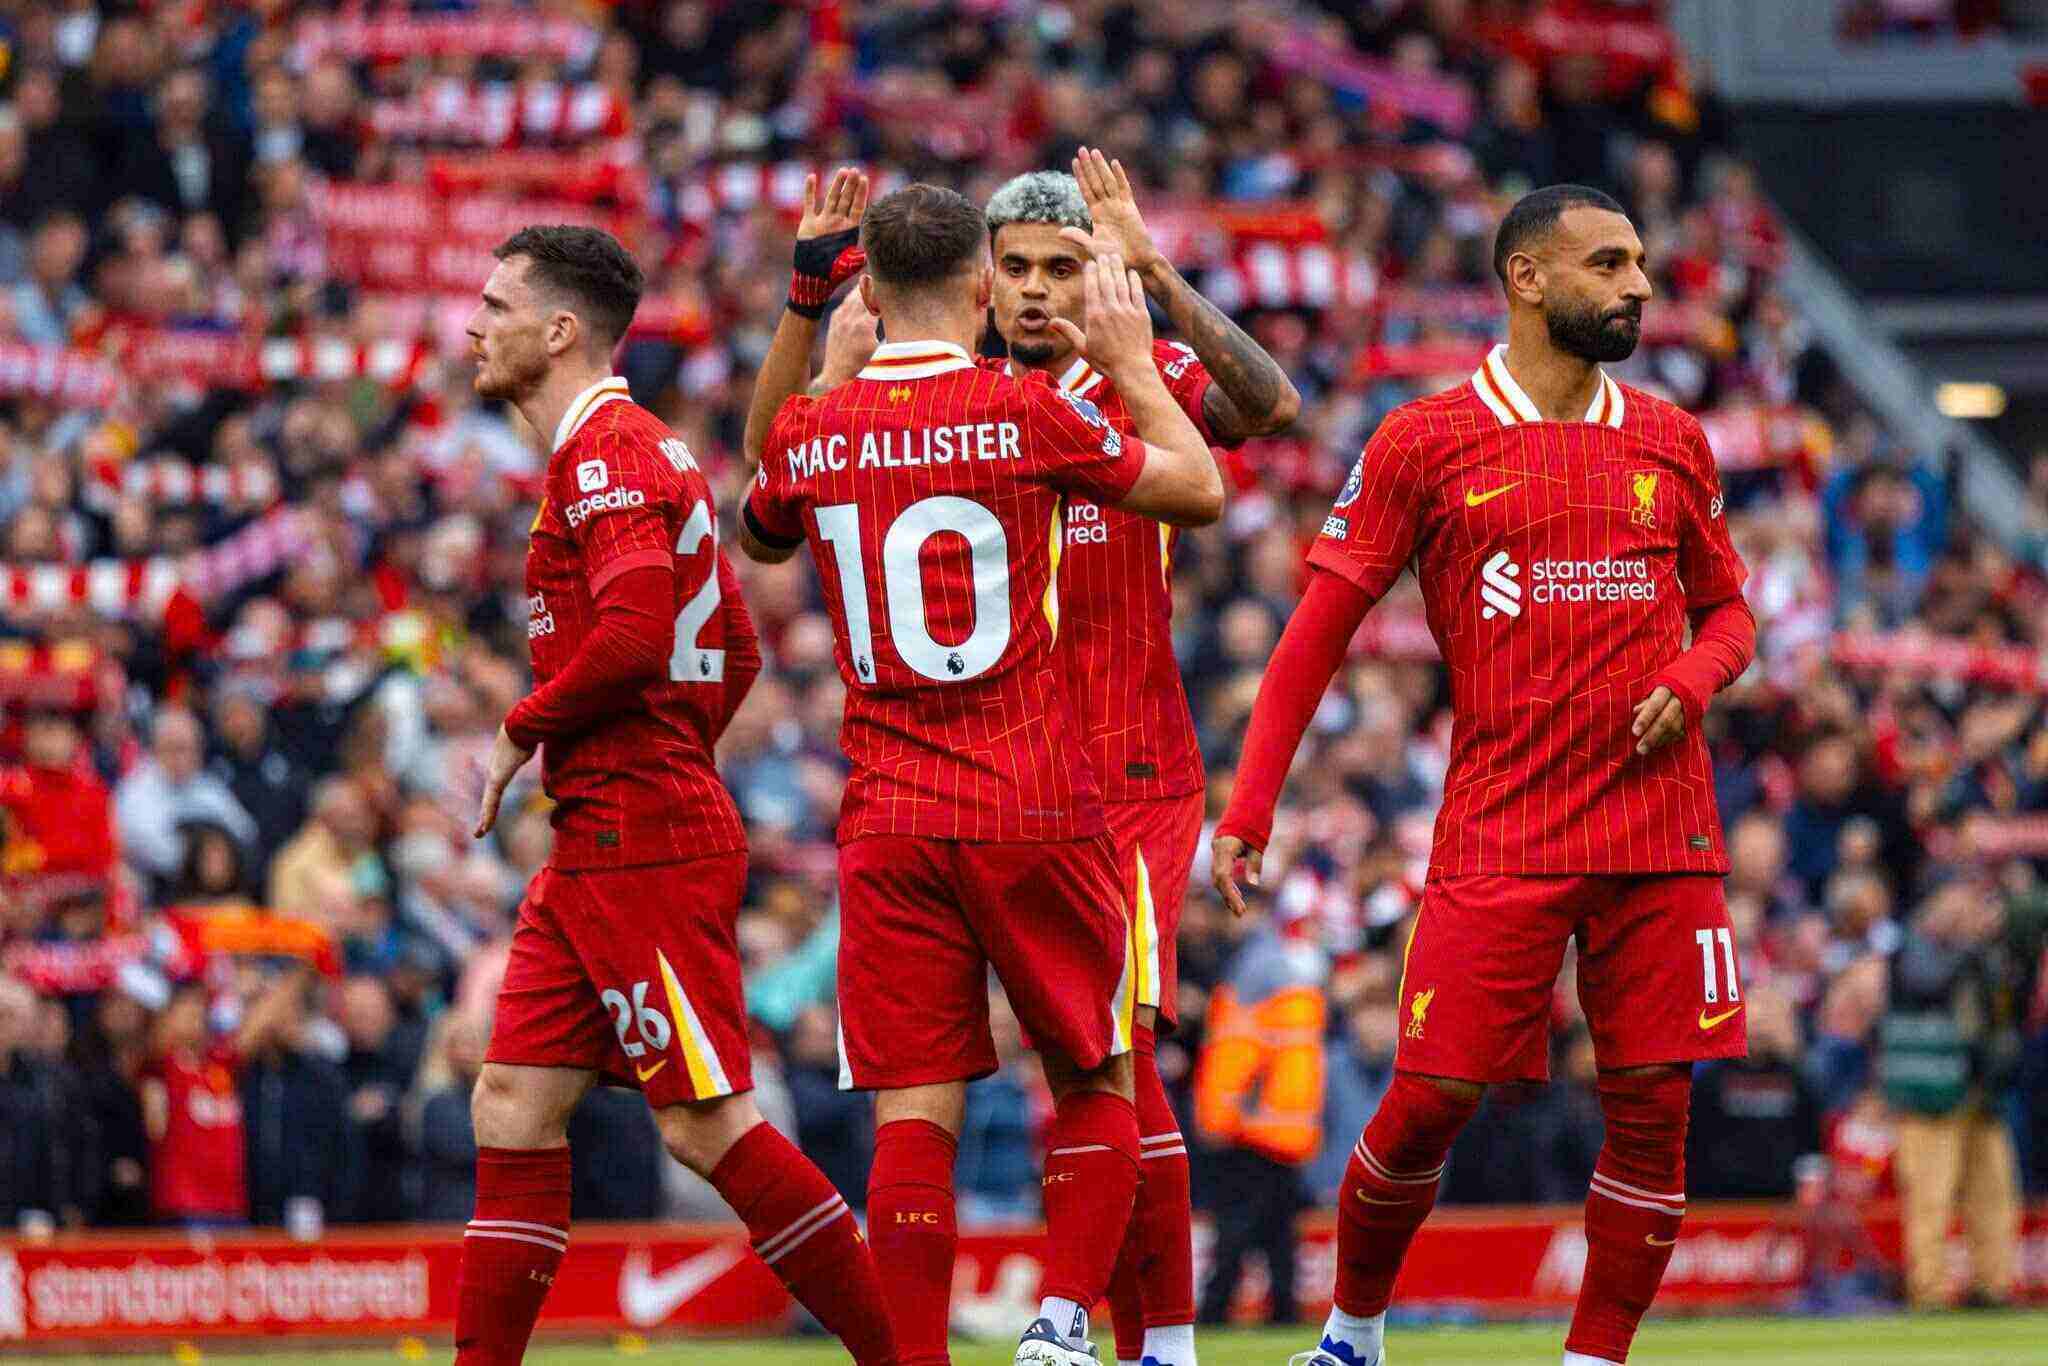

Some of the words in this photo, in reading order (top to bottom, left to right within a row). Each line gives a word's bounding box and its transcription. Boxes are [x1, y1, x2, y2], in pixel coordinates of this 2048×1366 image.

[787, 434, 847, 484] MAC
[858, 422, 1021, 469] ALLISTER
[1631, 510, 1657, 529] LFC
[814, 495, 1012, 684] 10
[1532, 557, 1647, 580] standard
[1532, 579, 1656, 603] chartered
[1696, 928, 1740, 1003] 11
[602, 981, 671, 1058] 26
[895, 1211, 938, 1224] LFC
